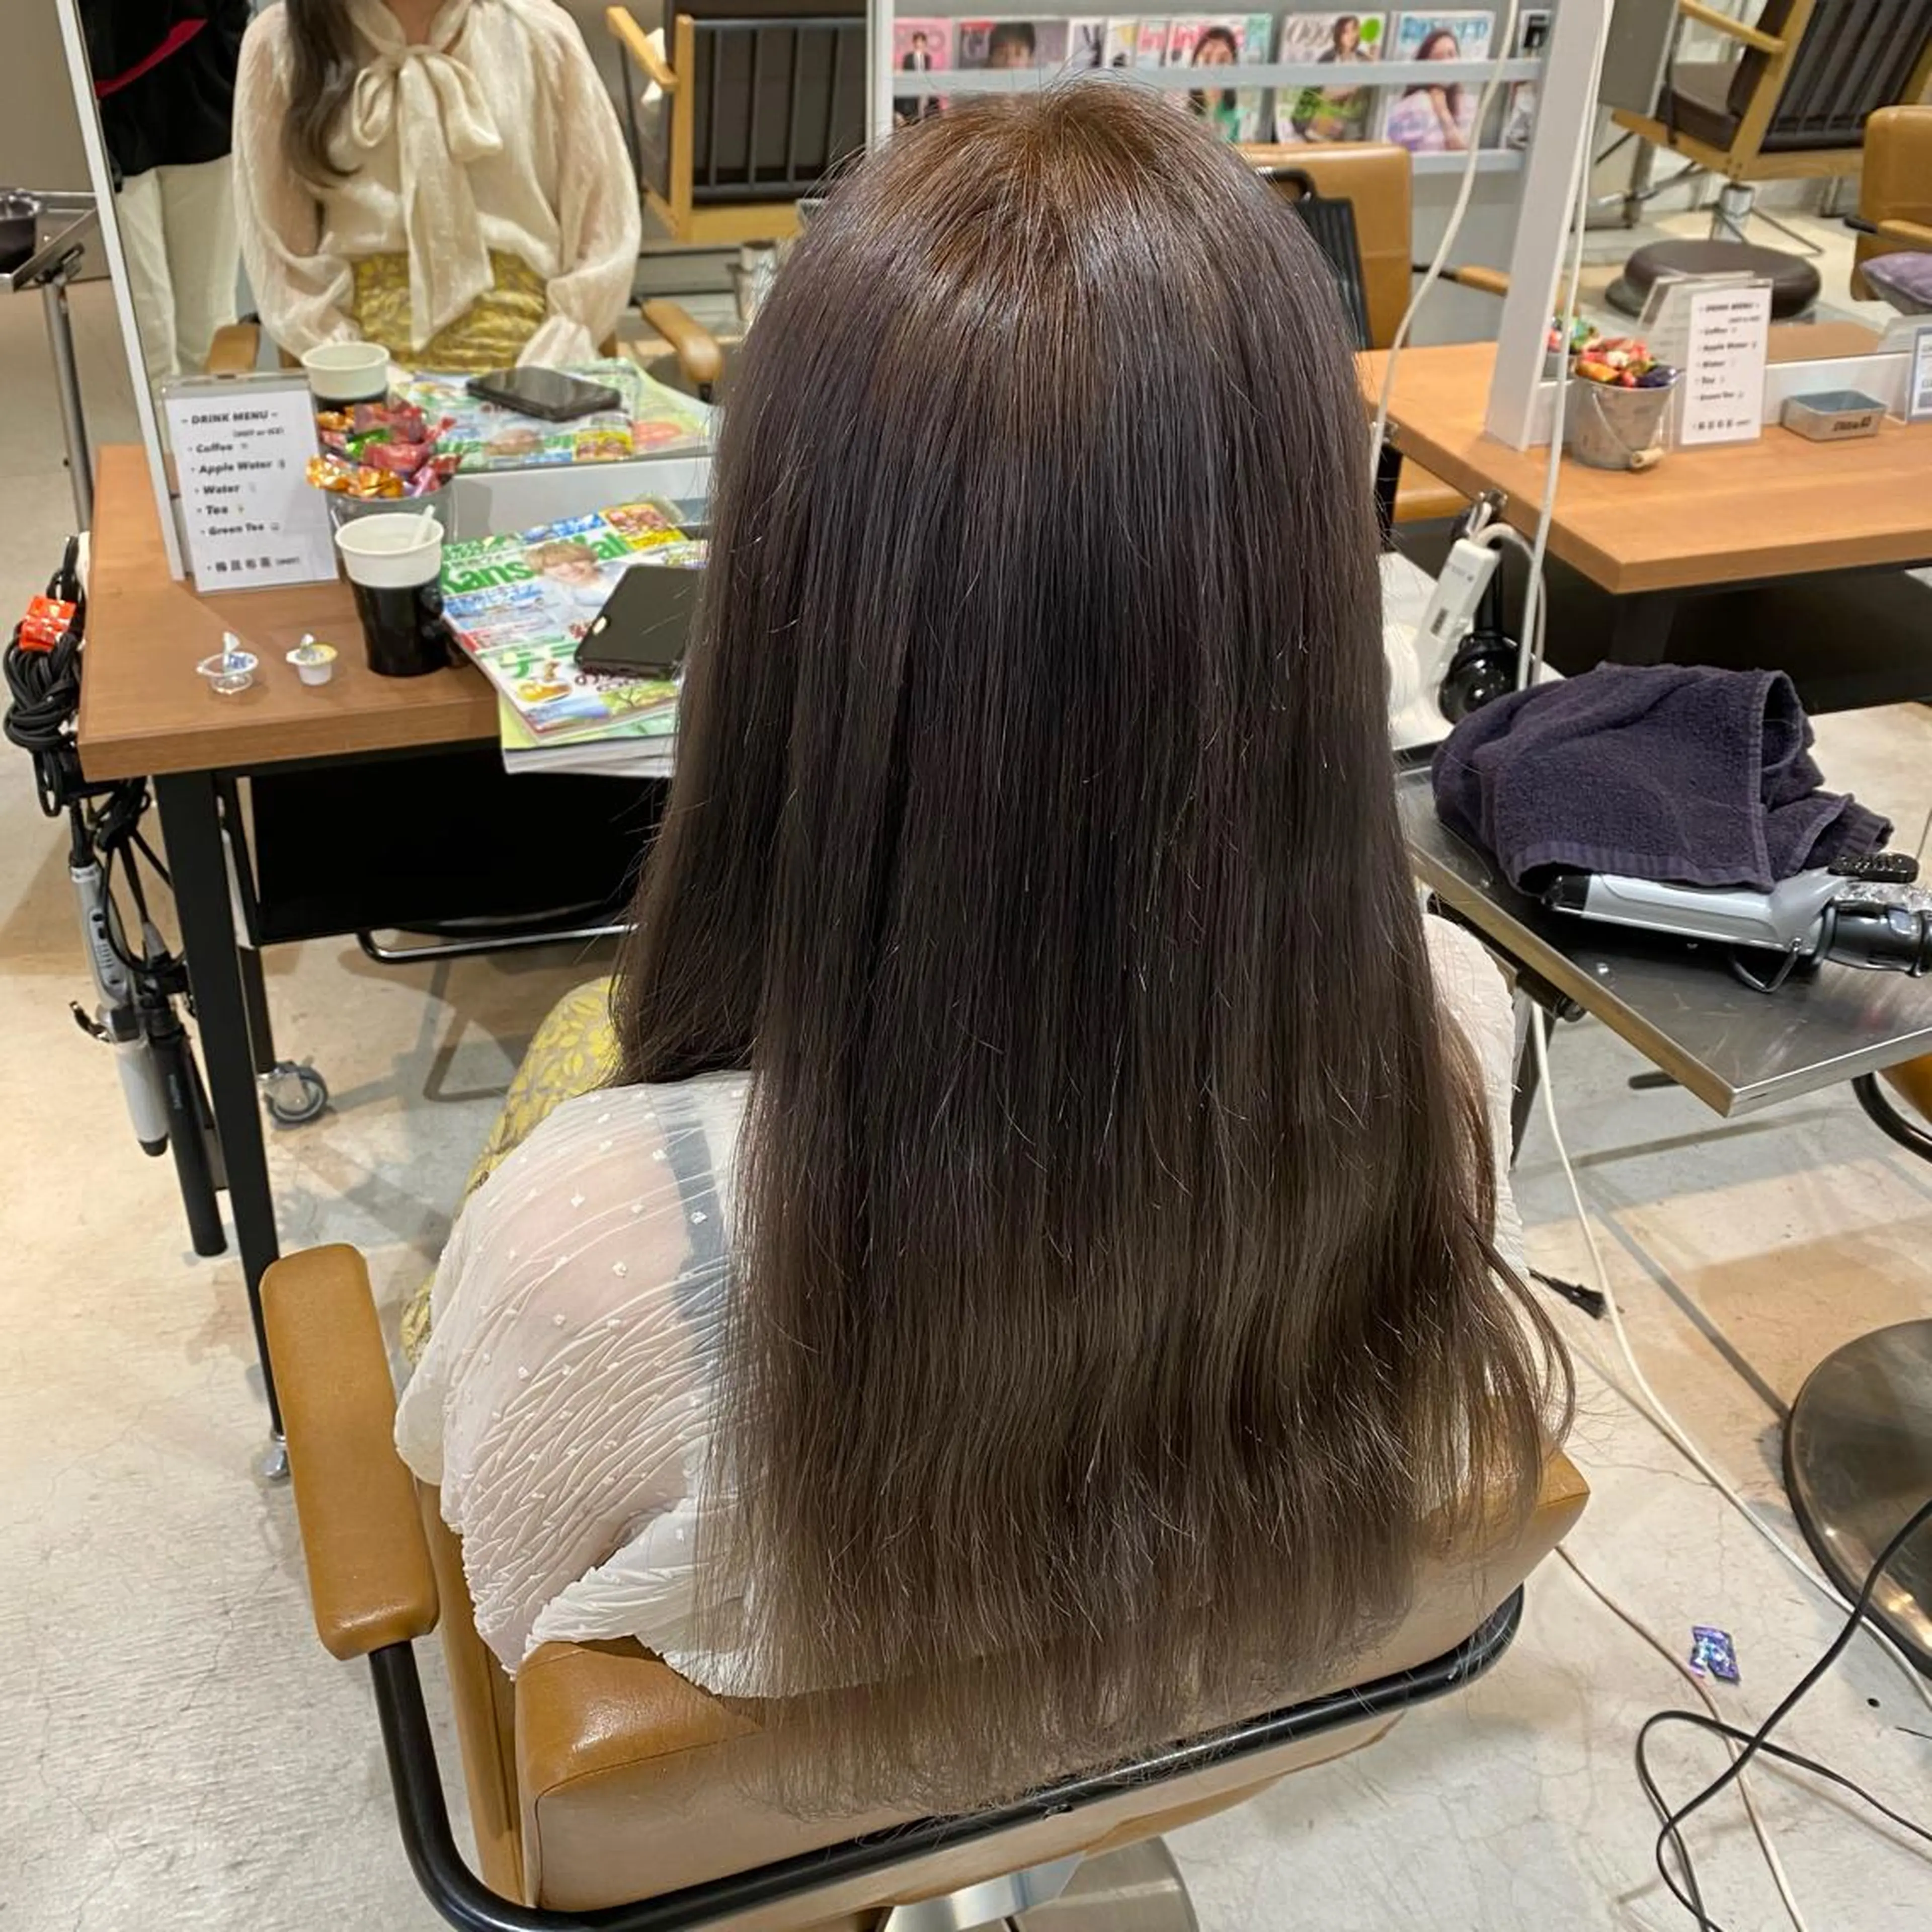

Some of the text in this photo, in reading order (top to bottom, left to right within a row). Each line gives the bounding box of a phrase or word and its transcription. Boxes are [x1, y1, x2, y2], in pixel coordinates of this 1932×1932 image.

[192, 410, 268, 424] DRINK MENU
[196, 443, 233, 453] Coffee
[199, 460, 272, 475] Apple Water
[204, 485, 239, 494] Water
[206, 505, 228, 514] Tea
[209, 522, 264, 535] Green Tea
